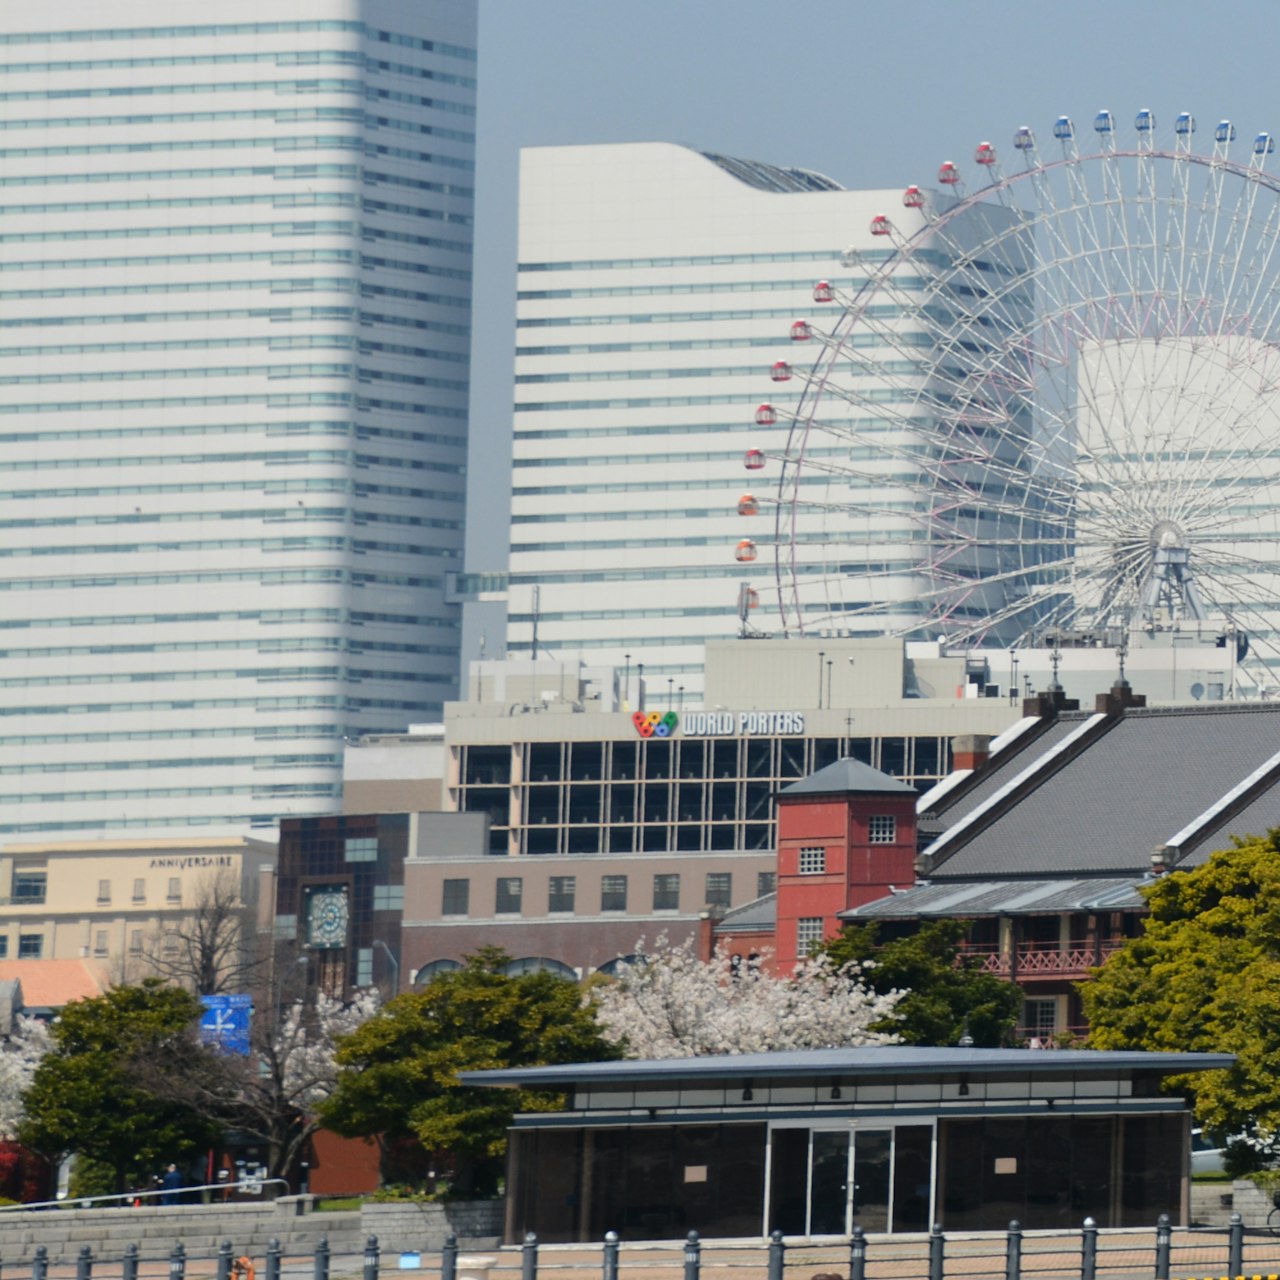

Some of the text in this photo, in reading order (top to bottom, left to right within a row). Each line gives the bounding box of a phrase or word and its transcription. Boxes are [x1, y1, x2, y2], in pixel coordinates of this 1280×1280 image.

[683, 711, 734, 736] WORLD
[739, 711, 804, 735] PORTERS
[150, 856, 232, 870] ANNIVERSAIRE
